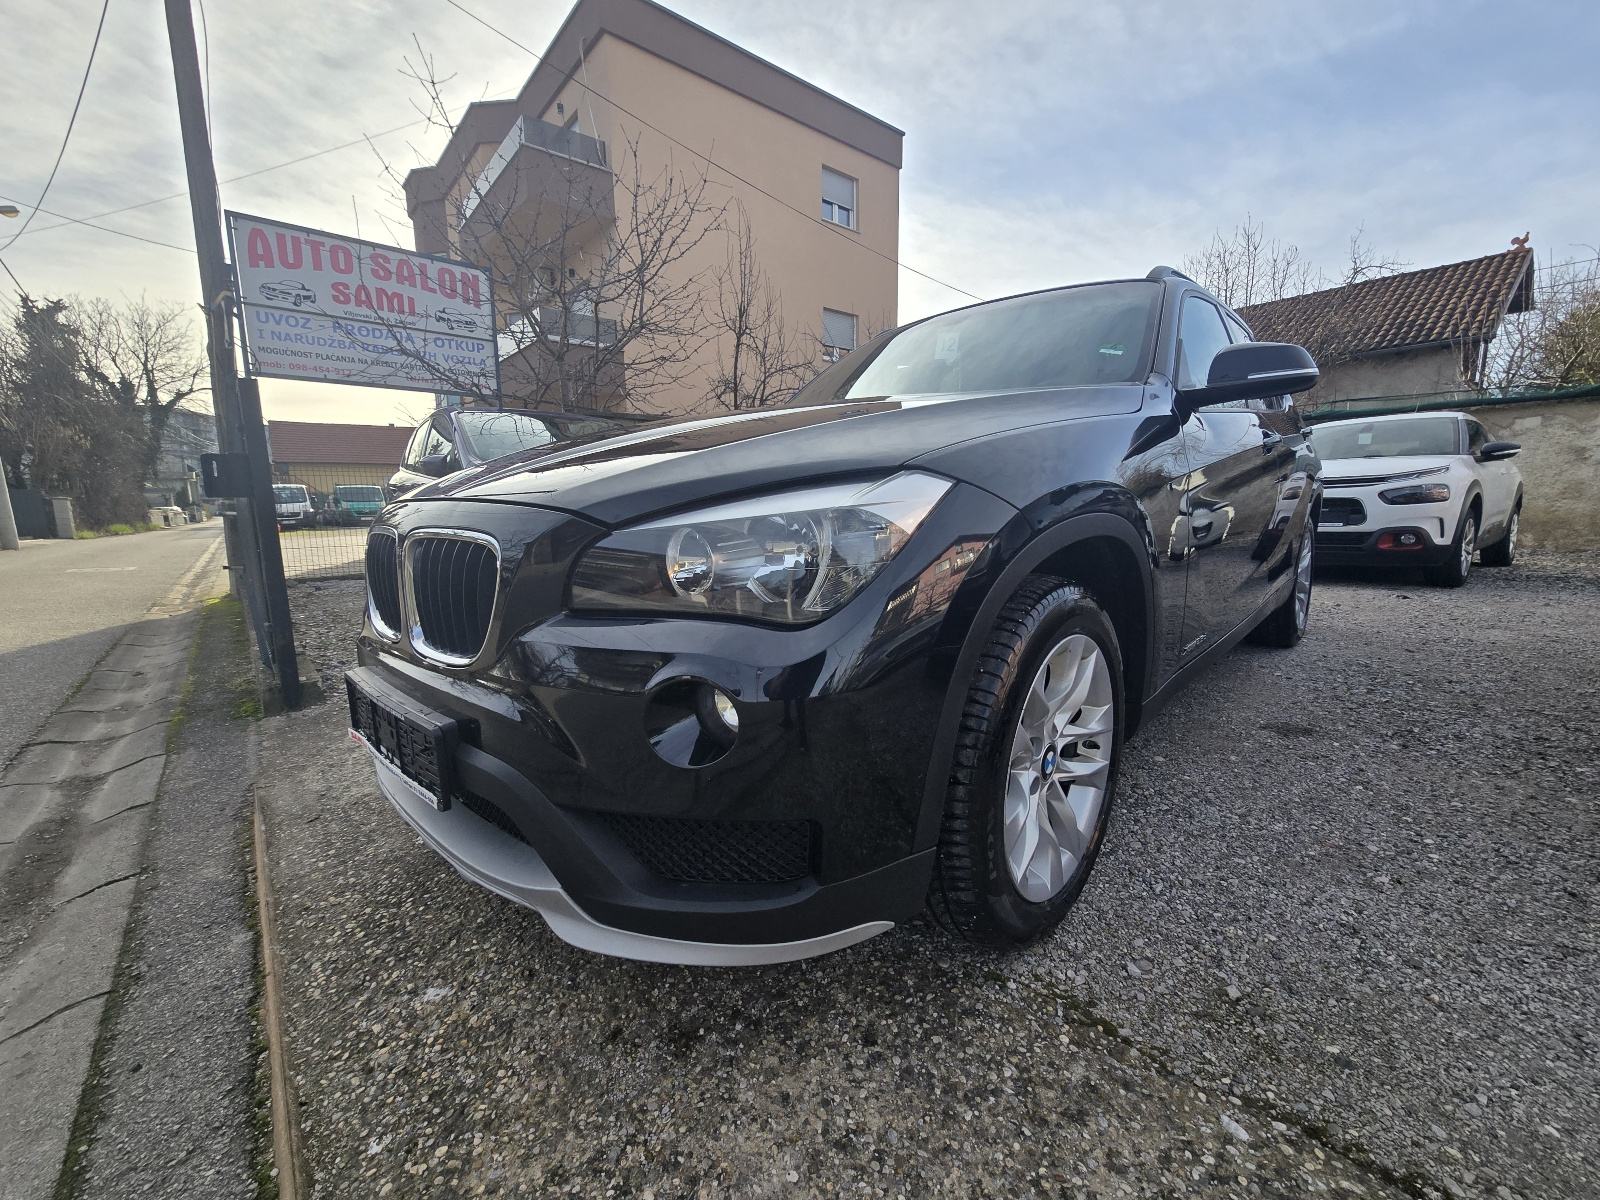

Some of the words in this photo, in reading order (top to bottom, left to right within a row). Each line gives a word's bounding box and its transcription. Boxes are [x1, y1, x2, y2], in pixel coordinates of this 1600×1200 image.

[247, 227, 354, 275] AUTO
[369, 252, 482, 310] SALON
[331, 281, 417, 317] SAMI
[256, 310, 312, 330] UVOZ
[332, 320, 416, 344] PRODAJA
[433, 336, 485, 353] OTKUP
[257, 328, 265, 339] I
[270, 330, 357, 350] NARUDŽBA
[442, 352, 487, 367] VOZILA
[257, 346, 313, 359] MOGUĆNOST
[315, 352, 356, 364] PLAĆANJA
[357, 357, 369, 365] NA
